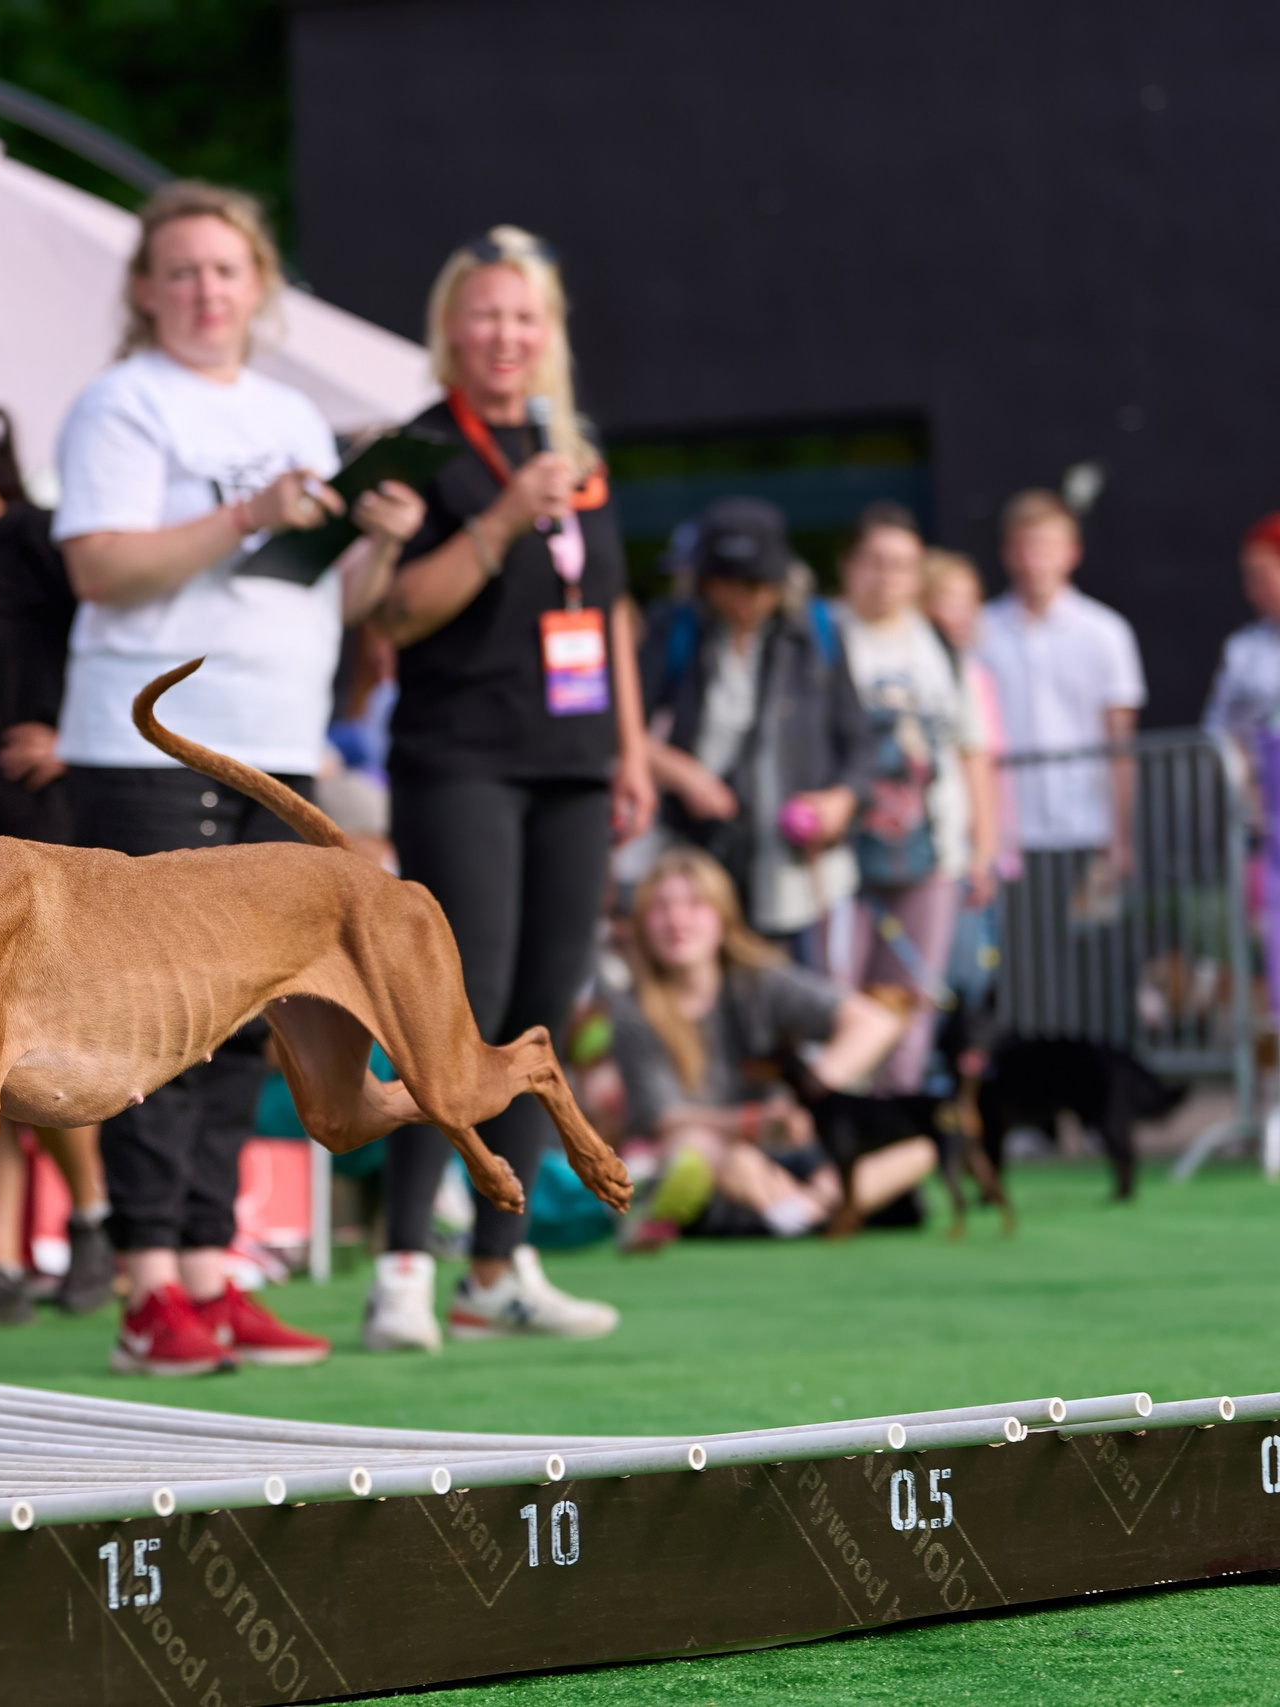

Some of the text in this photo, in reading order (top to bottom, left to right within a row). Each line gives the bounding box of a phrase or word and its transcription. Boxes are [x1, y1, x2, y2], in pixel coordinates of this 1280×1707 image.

[797, 1461, 890, 1606] Plywood
[889, 1467, 954, 1532] 0.5
[98, 1537, 163, 1611] 1.5
